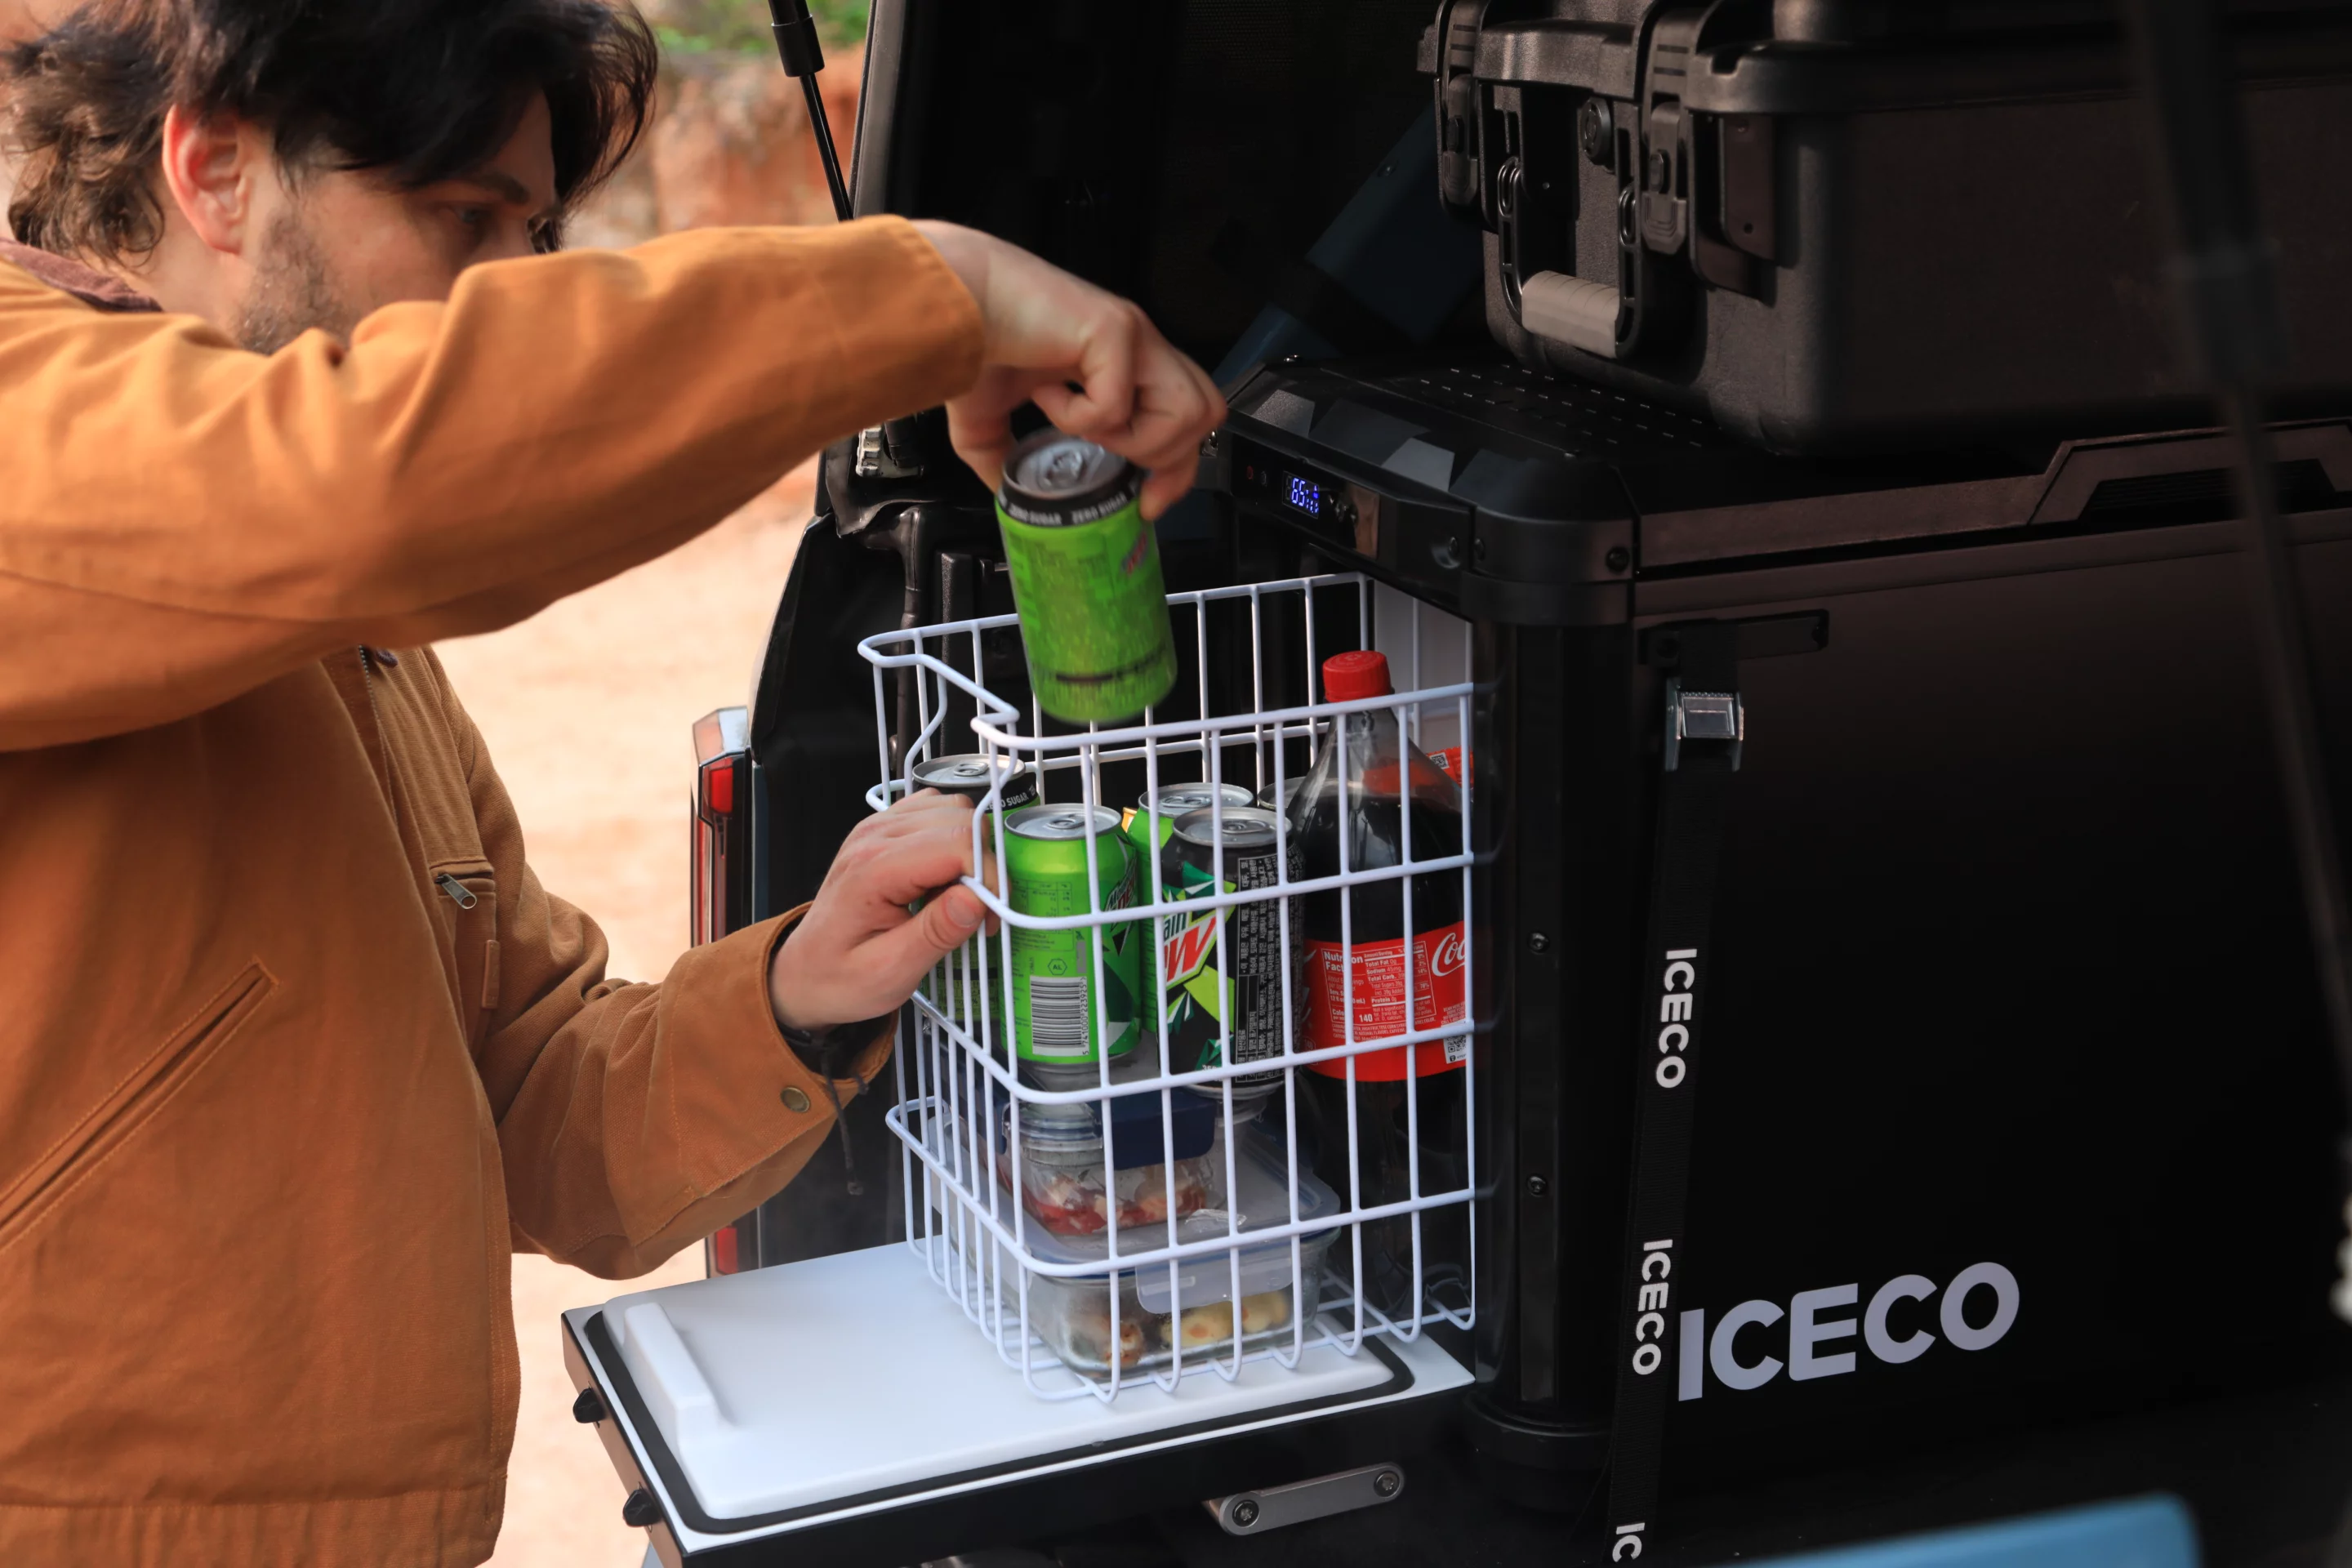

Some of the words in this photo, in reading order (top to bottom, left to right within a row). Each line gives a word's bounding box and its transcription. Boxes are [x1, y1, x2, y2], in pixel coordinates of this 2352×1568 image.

[1006, 792, 1029, 807] SUGAR
[1164, 912, 1186, 940] ain
[1324, 951, 1364, 964] Nutron
[1325, 961, 1344, 972] Fact
[1359, 1013, 1373, 1022] 140
[1655, 948, 1697, 1089] ICECO
[1633, 1239, 1673, 1375] ICECO
[1678, 1262, 2020, 1401] ICECO
[1612, 1522, 1645, 1562] IC
